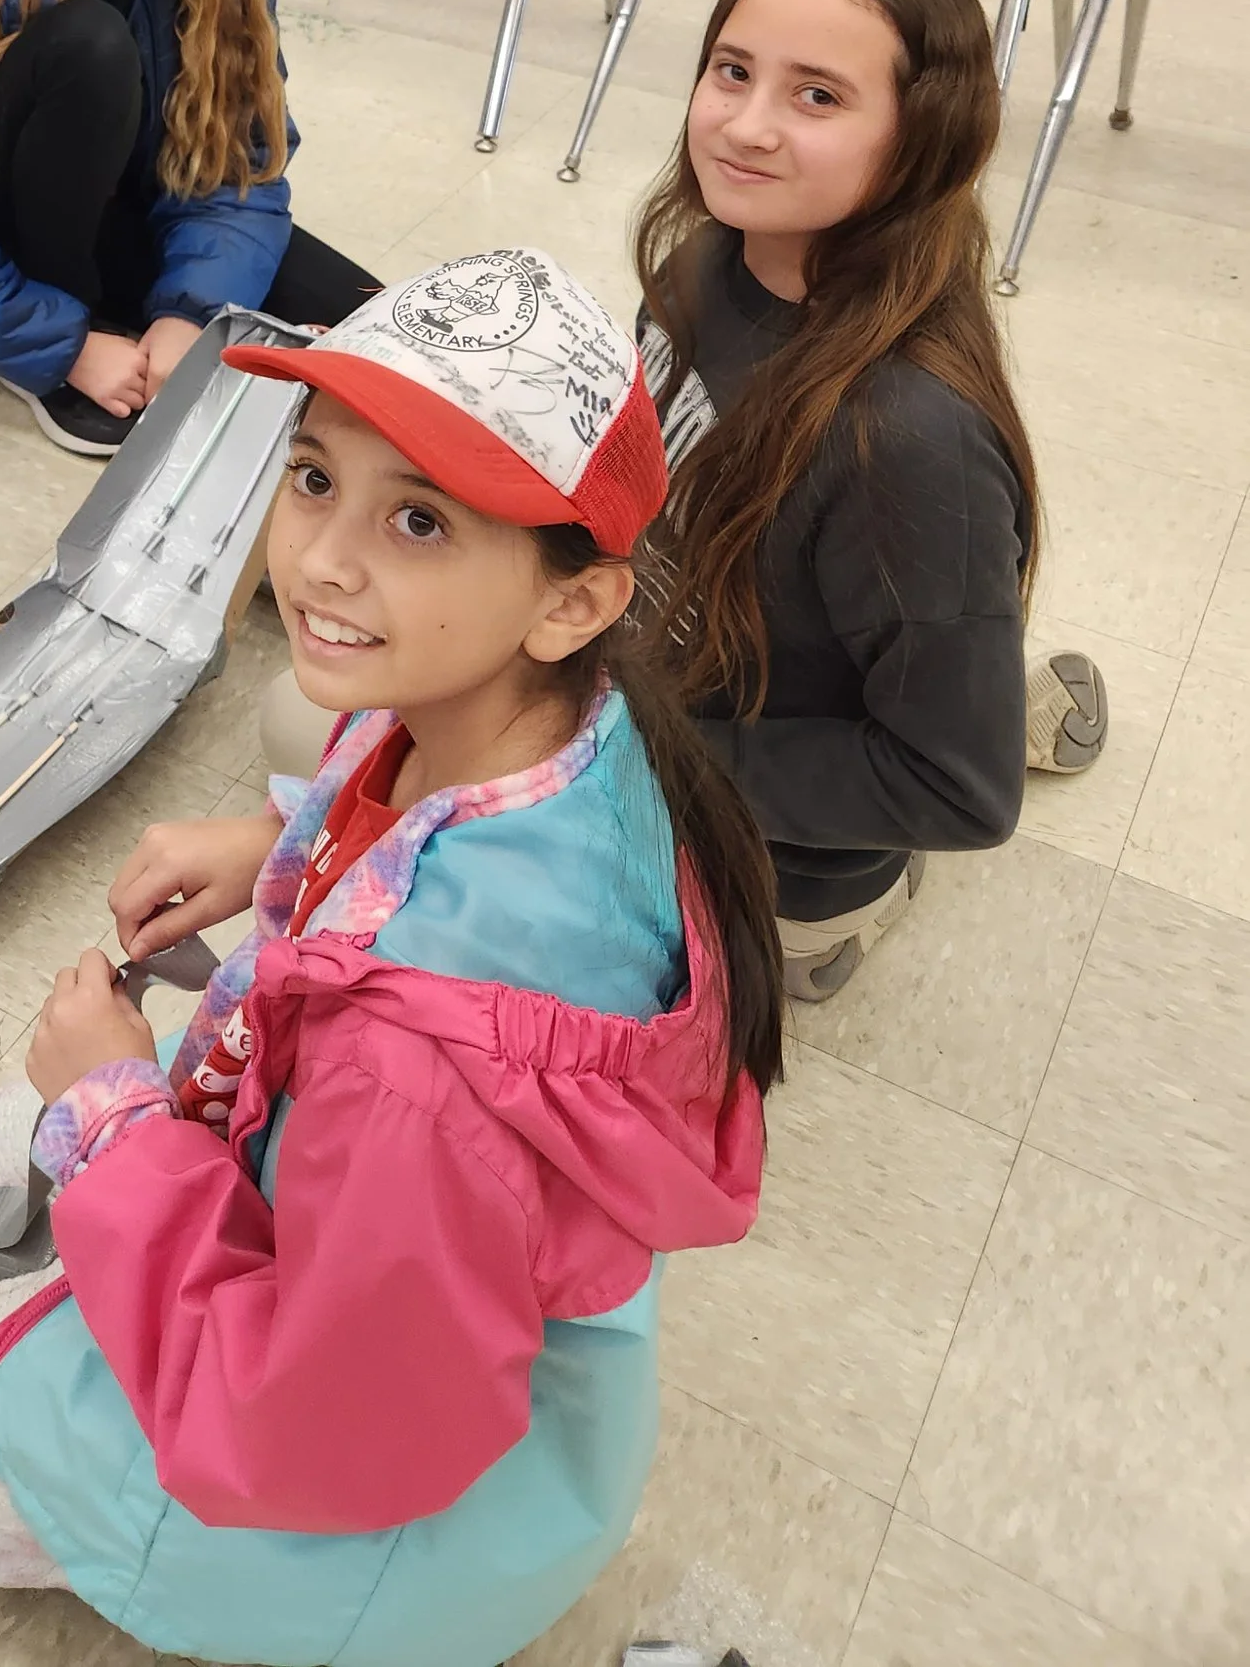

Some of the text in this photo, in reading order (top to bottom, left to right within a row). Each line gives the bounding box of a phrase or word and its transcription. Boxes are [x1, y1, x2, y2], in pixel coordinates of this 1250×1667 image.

[425, 256, 505, 281] RUNNING
[504, 265, 535, 323] SPRINGS
[397, 302, 484, 349] ELEMENTARY
